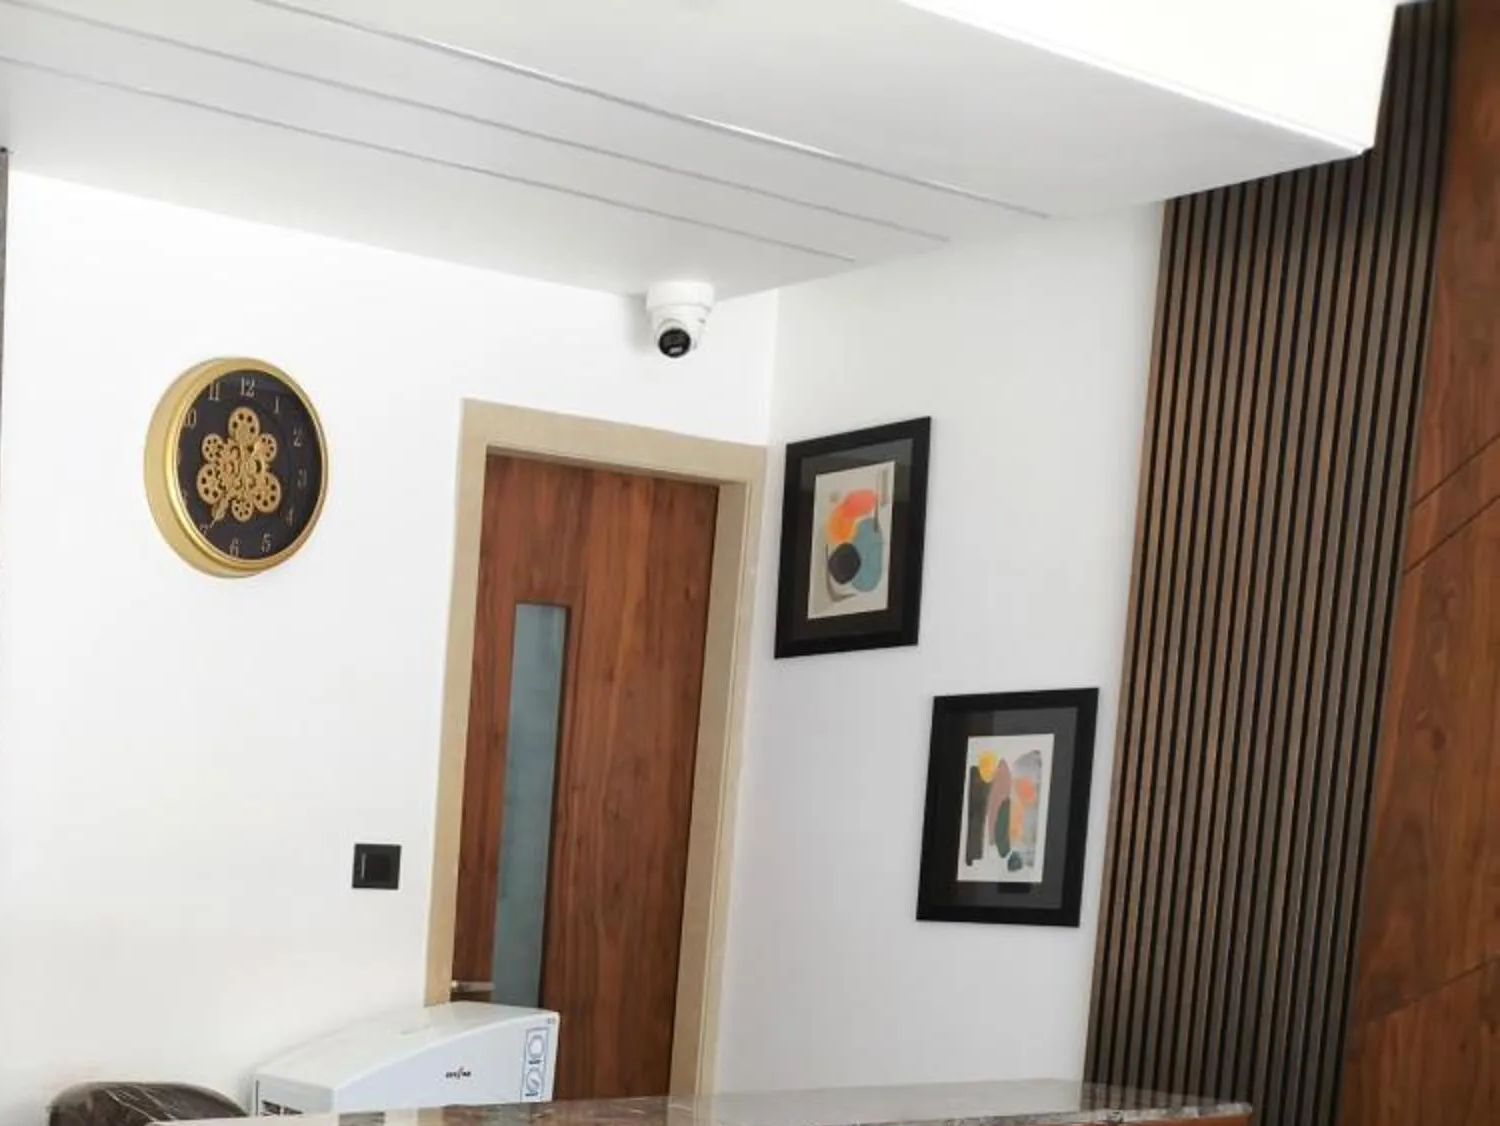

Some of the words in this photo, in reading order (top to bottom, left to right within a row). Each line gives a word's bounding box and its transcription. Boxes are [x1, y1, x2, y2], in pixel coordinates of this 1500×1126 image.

[207, 379, 220, 401] 11
[240, 376, 256, 398] 12
[273, 395, 281, 415] 1
[293, 427, 303, 448] 2
